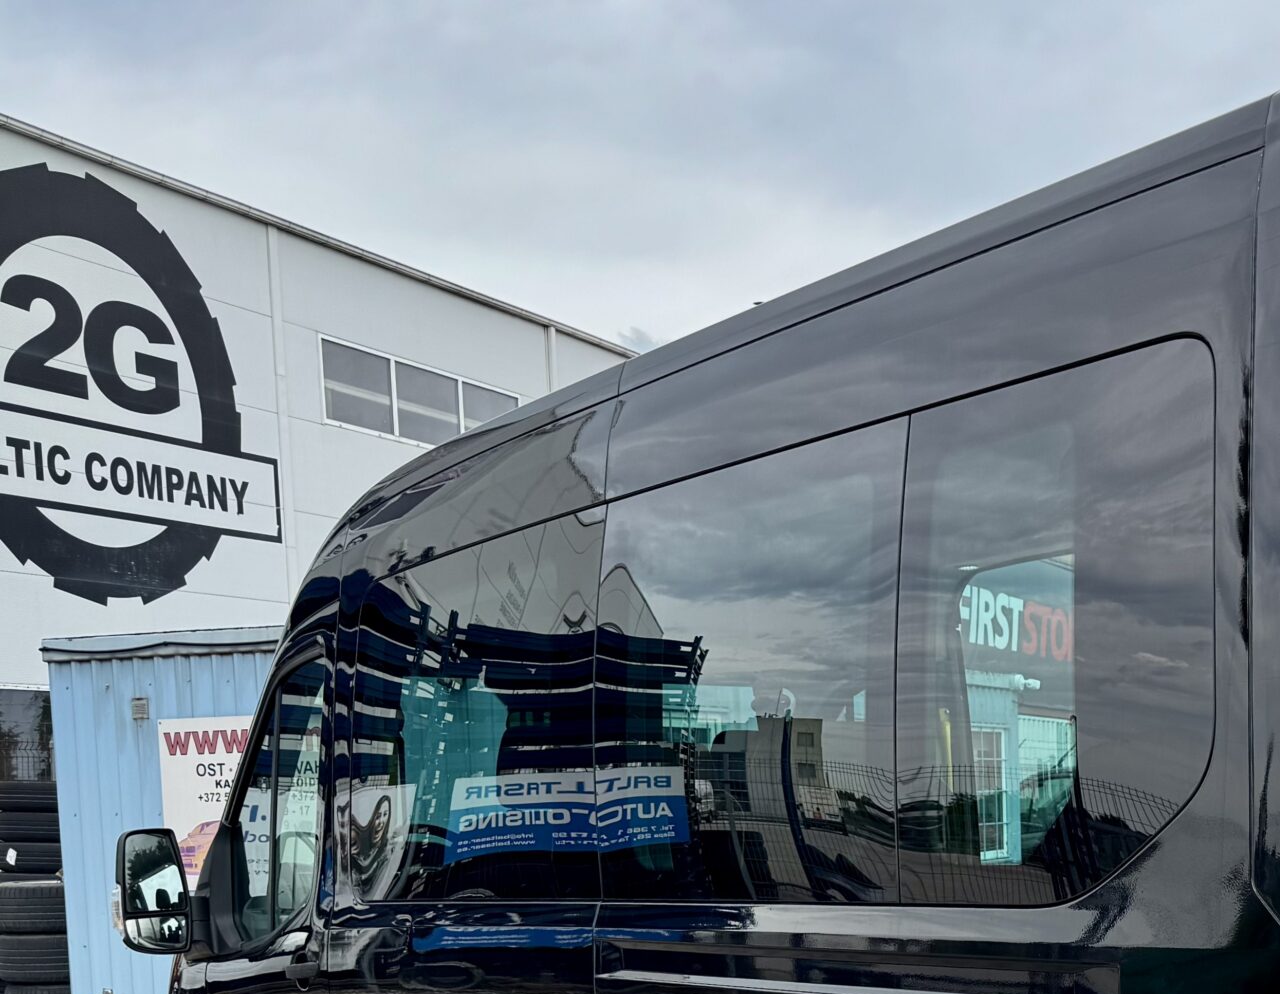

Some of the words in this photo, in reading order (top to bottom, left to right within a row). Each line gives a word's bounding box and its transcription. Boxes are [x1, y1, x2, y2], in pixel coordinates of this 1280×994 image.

[0, 274, 180, 415] 2G
[85, 452, 249, 515] COMPANY
[196, 762, 225, 777] OST
[198, 792, 221, 802] +372
